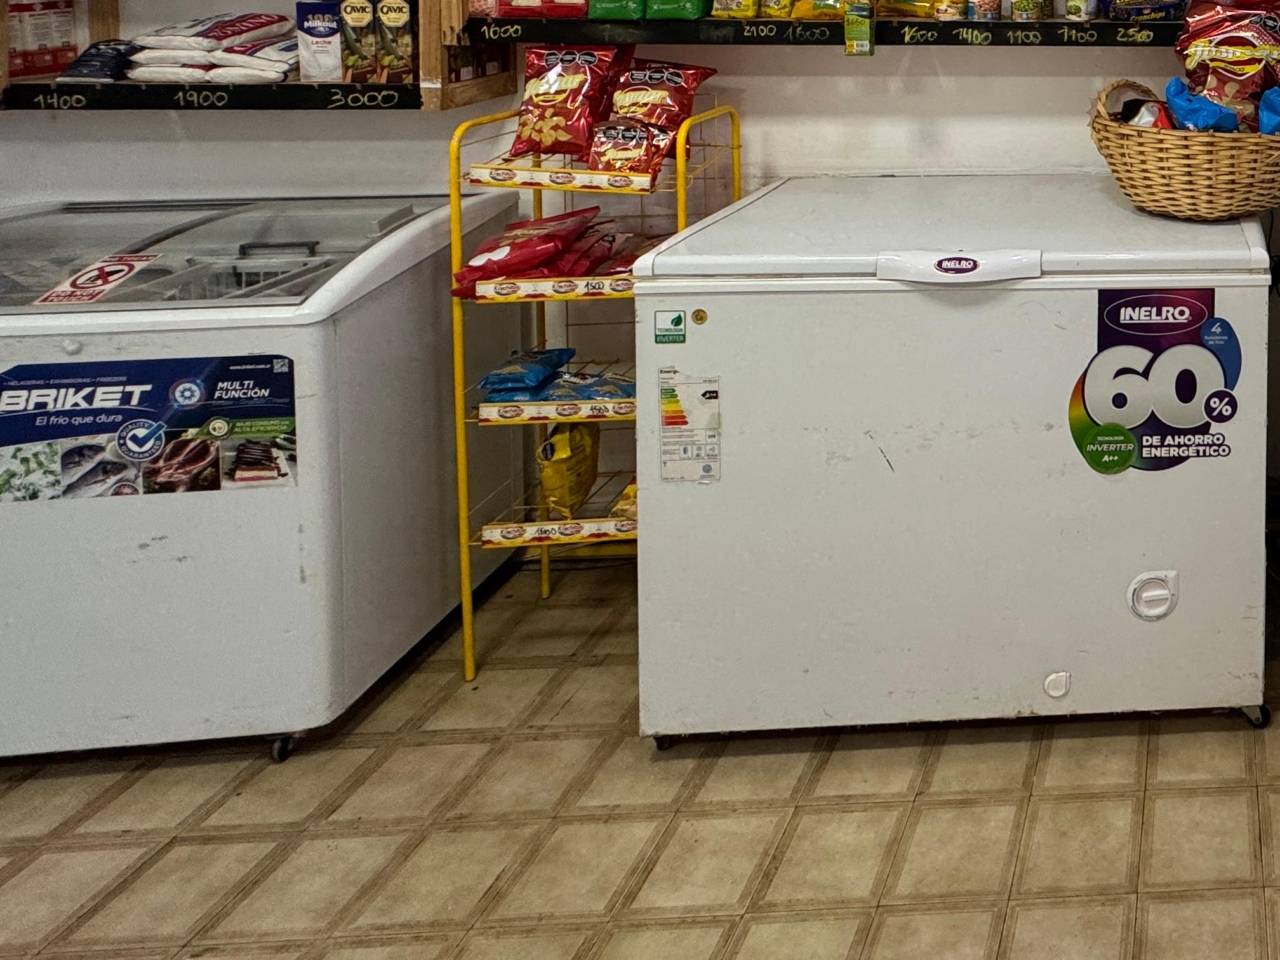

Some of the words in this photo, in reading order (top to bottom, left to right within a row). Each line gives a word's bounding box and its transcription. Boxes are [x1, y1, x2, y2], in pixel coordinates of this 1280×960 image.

[343, 4, 371, 15] CAVIC
[380, 4, 407, 15] CAVIC
[481, 24, 522, 40] 1600
[743, 25, 777, 37] 2100
[1007, 30, 1042, 44] 1100
[33, 93, 87, 109] 1400
[173, 91, 228, 106] 1900
[327, 89, 399, 109] 3000
[942, 260, 974, 268] INELRO
[1120, 306, 1190, 321] INELRO
[1211, 322, 1223, 334] 4
[217, 380, 255, 390] MULTI
[0, 384, 153, 411] BRIKET
[214, 387, 270, 399] FUNCIÓN
[35, 417, 47, 426] El
[71, 416, 94, 426] que
[96, 414, 122, 423] dura
[1142, 435, 1163, 446] DE
[1164, 435, 1225, 446] AHORRO
[1087, 443, 1135, 452] INVERTER
[1142, 443, 1230, 458] ENERGÉTICO
